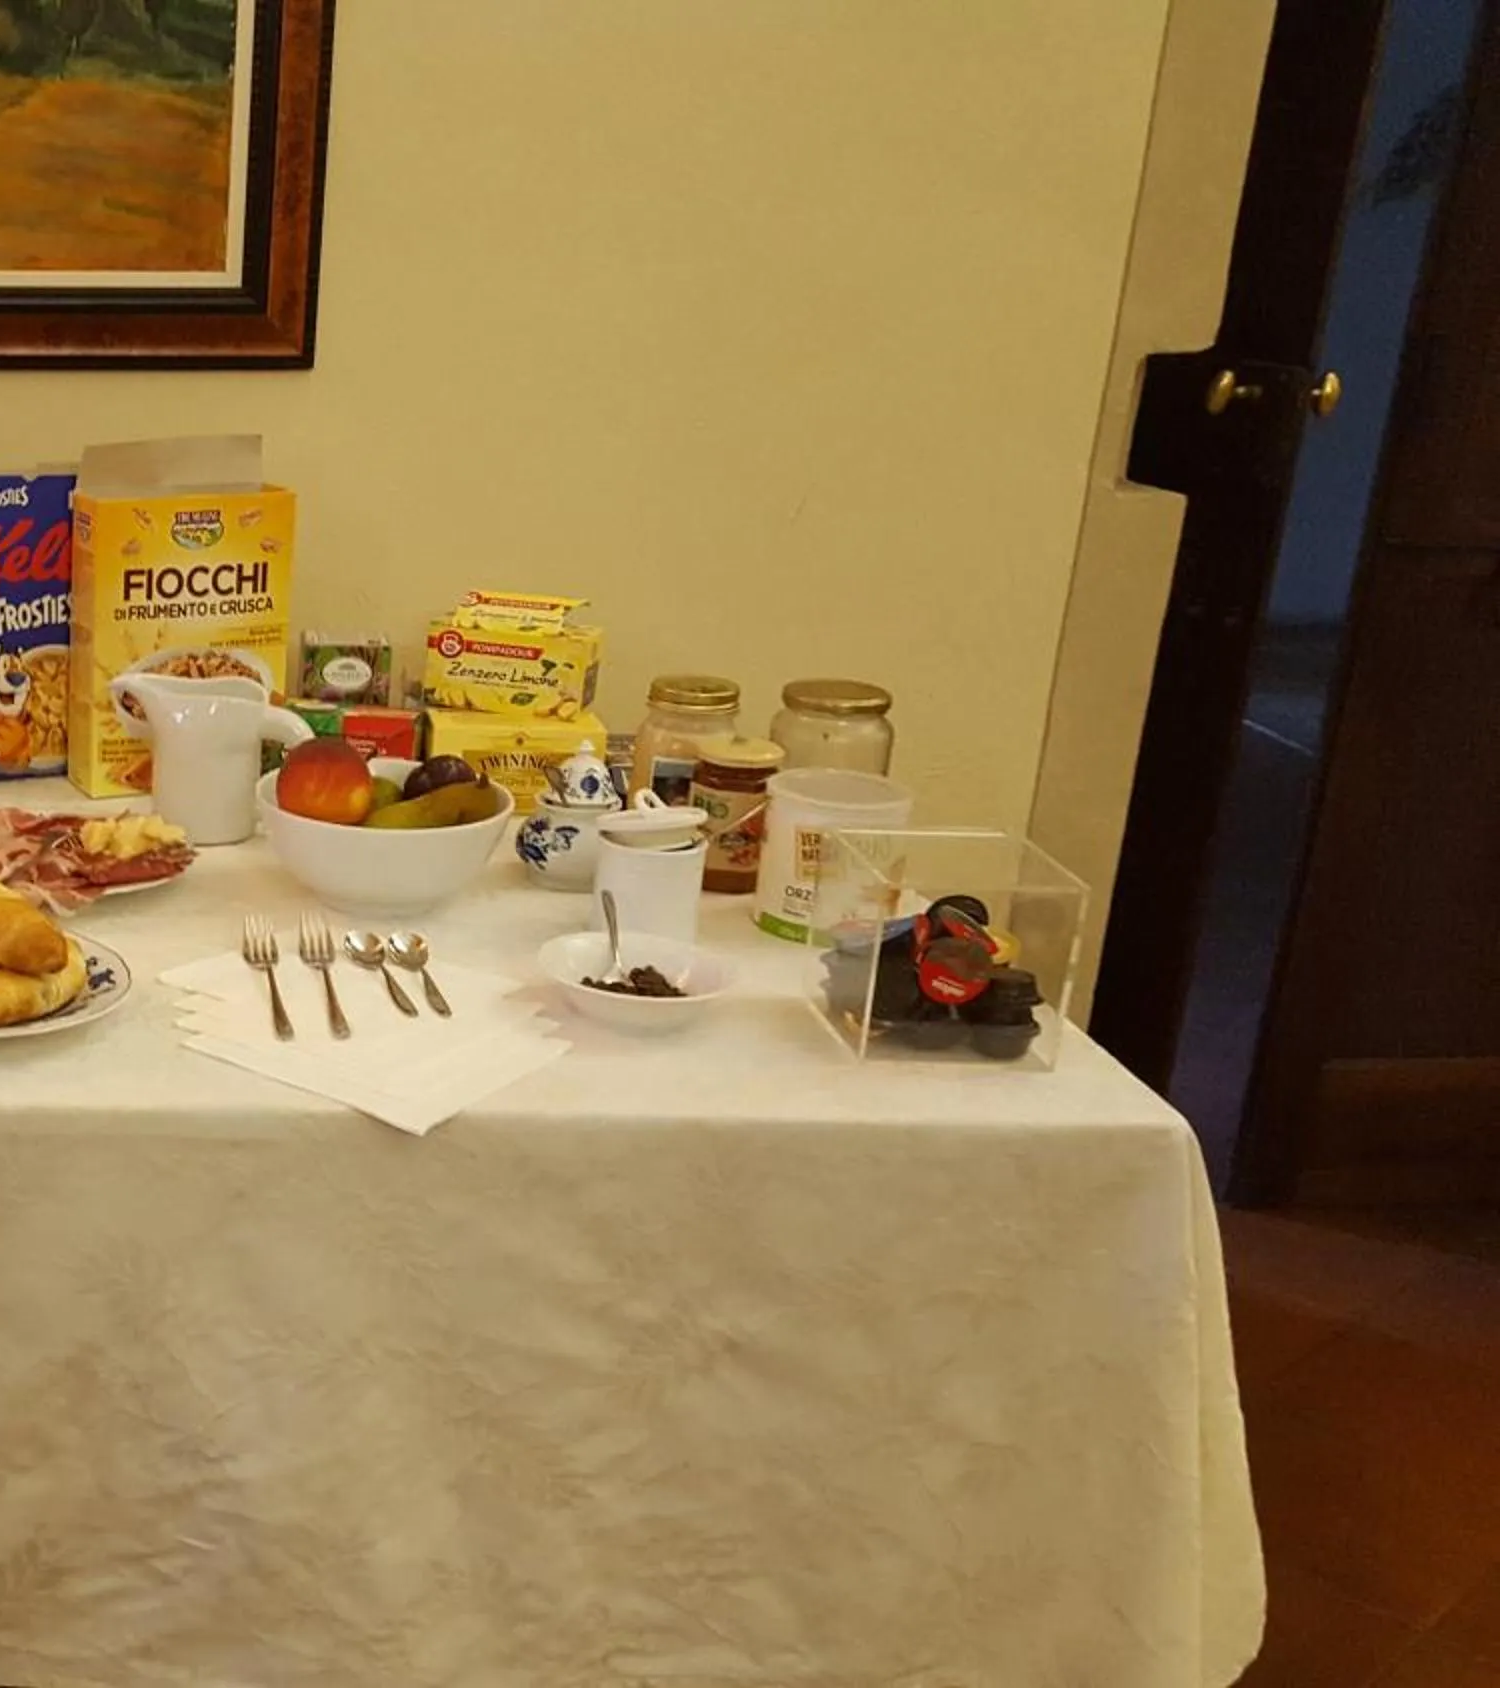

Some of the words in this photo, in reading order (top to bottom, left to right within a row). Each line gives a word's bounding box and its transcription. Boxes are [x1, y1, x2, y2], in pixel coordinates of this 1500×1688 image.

[123, 561, 269, 601] FIOCCHI
[114, 608, 127, 621] DI
[128, 602, 208, 620] FRUMENTO
[219, 597, 274, 615] CRUSCA
[447, 660, 507, 681] Zenzero
[509, 667, 560, 688] Limone
